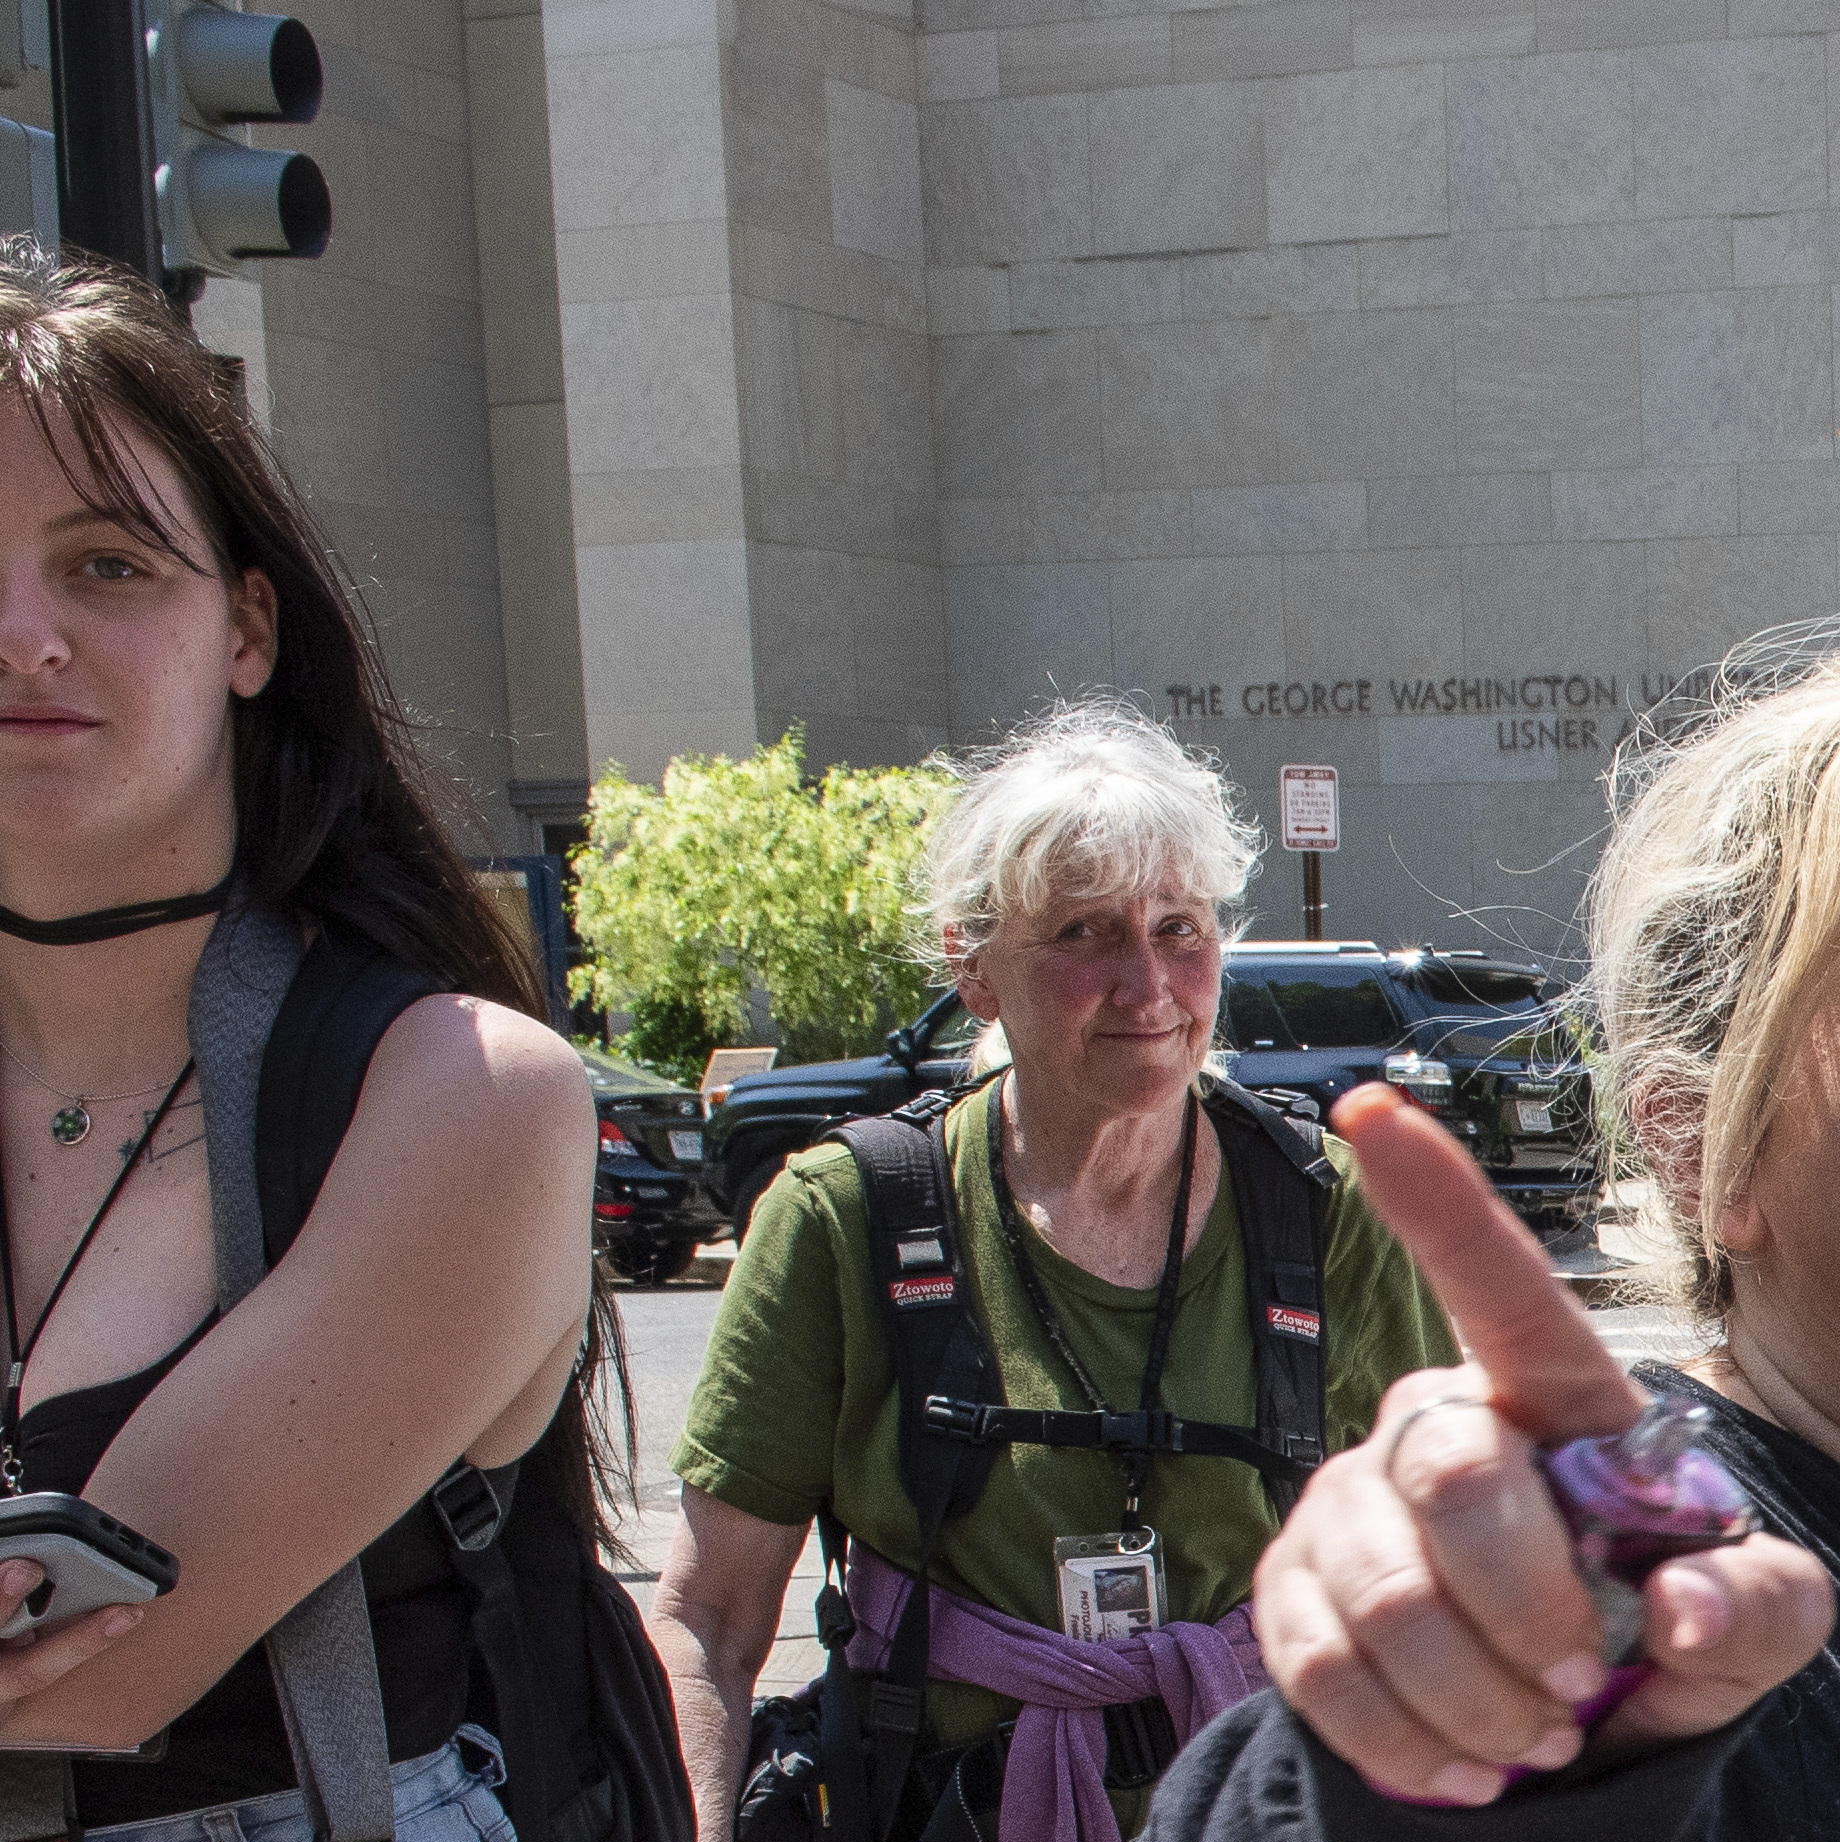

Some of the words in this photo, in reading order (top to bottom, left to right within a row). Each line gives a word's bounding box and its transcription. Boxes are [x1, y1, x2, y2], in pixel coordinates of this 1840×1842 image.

[1166, 683, 1224, 717] THE
[1242, 679, 1372, 716] GEORGE
[1388, 675, 1618, 713] WASHINGTON
[1498, 718, 1599, 751] LISNER
[893, 1282, 954, 1298] Ztowoto
[896, 1295, 925, 1306] QUICK
[1272, 1308, 1320, 1332] Ztowoto
